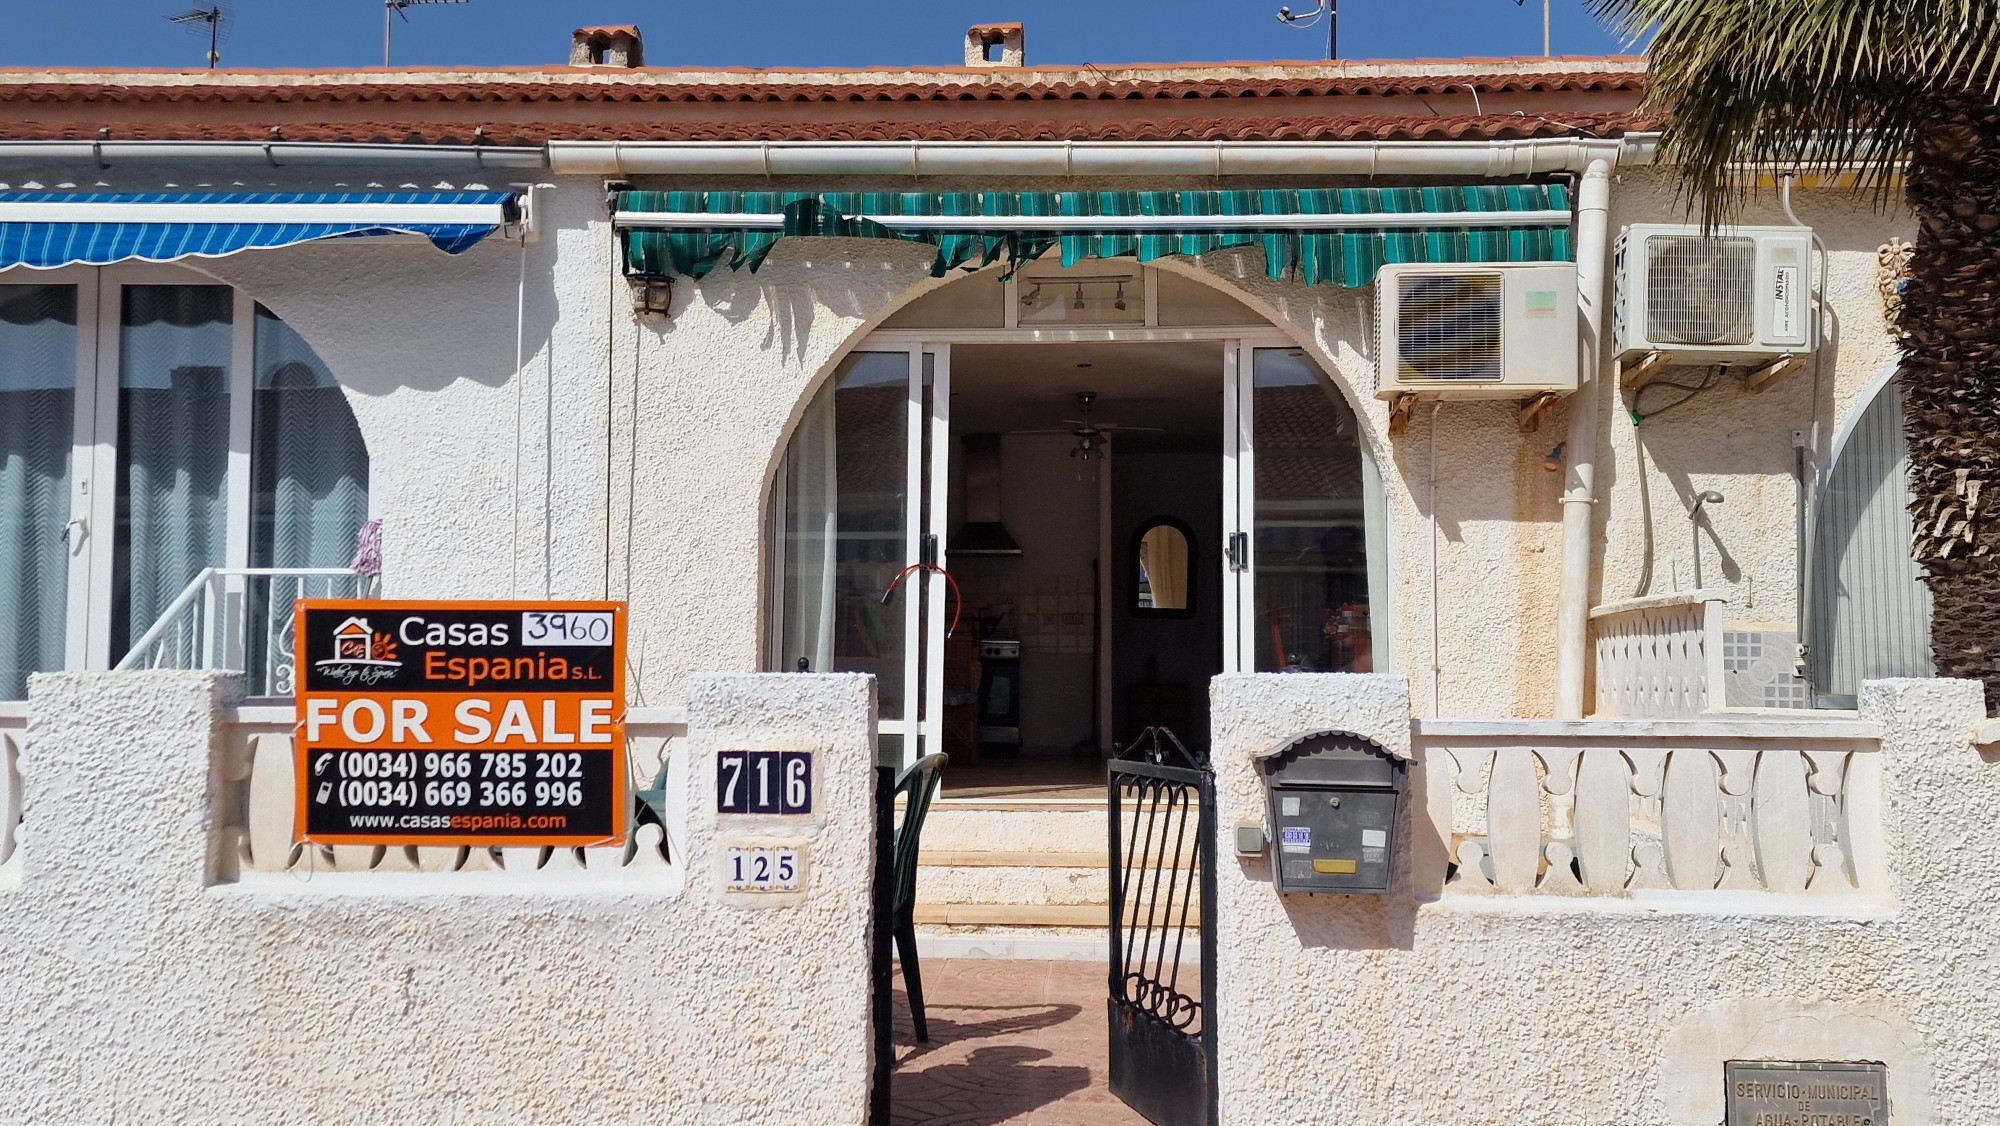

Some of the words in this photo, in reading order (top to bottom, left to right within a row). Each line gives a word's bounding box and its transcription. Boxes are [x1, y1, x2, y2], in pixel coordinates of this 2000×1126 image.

[1775, 269, 1784, 300] INSTAL
[399, 616, 510, 647] Casas
[527, 612, 610, 642] 3960
[425, 651, 568, 687] Espania
[571, 666, 602, 680] S.L.
[306, 698, 433, 744] FOR
[453, 698, 614, 745] SALE
[338, 751, 419, 779] (0034)
[424, 752, 472, 778] 966
[479, 752, 527, 778] 785
[535, 752, 583, 778] 202
[338, 781, 419, 808] (0034)
[424, 781, 472, 807] 669
[479, 781, 527, 807] 366
[535, 781, 583, 807] 996
[722, 756, 807, 808] 716
[349, 813, 567, 832] www.casasespania.com
[733, 855, 794, 882] 125
[1797, 1101, 1810, 1112] DE
